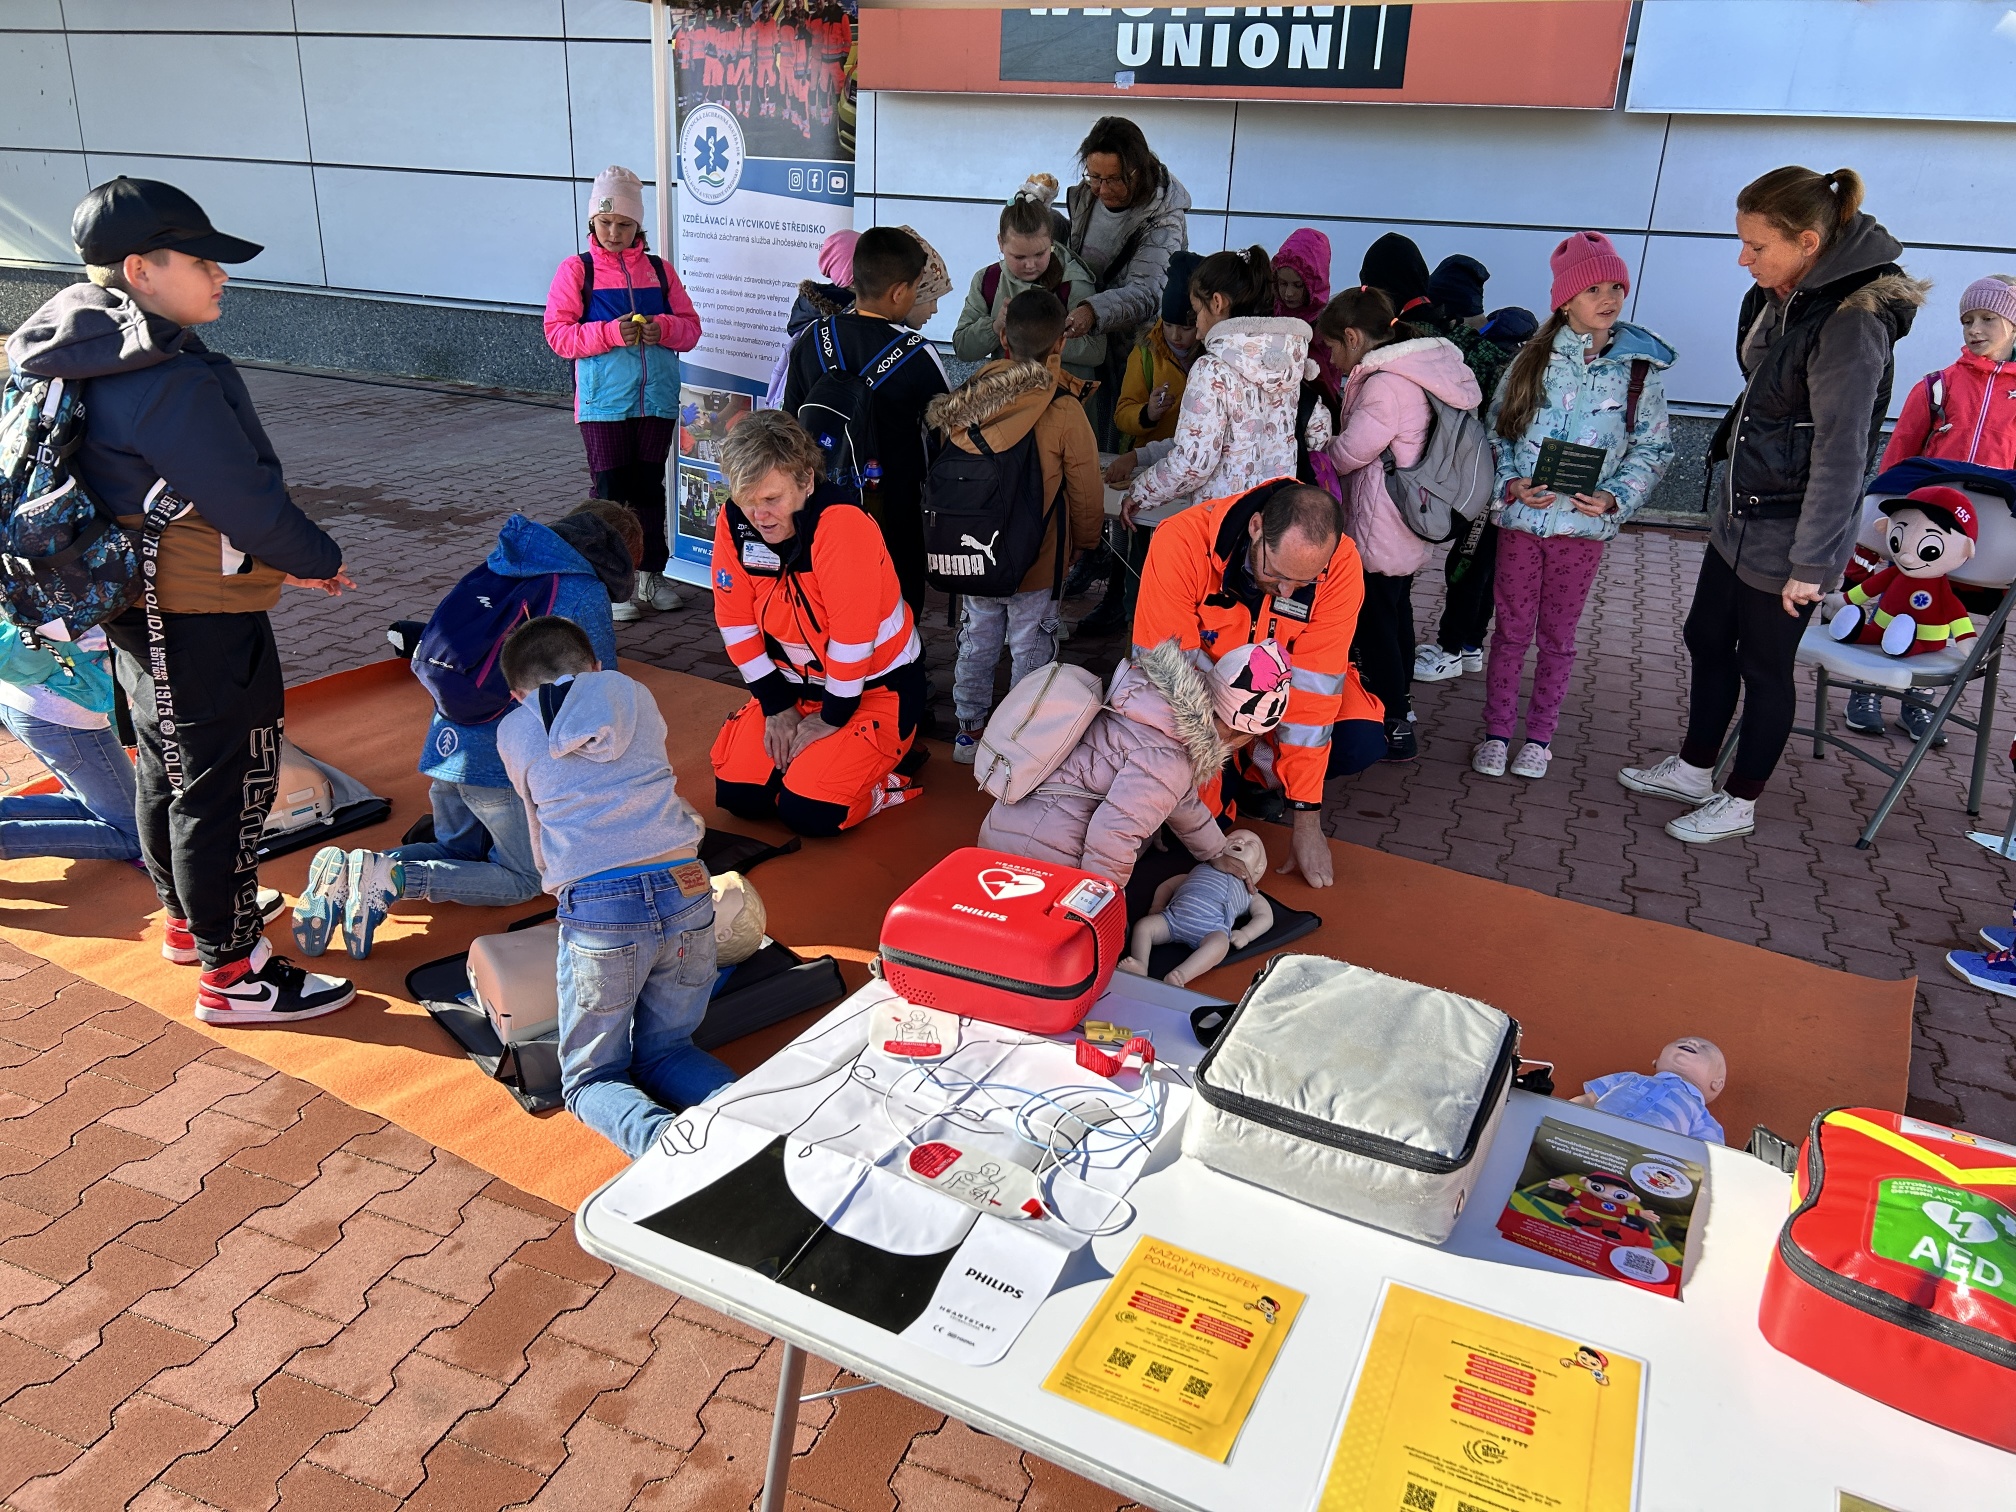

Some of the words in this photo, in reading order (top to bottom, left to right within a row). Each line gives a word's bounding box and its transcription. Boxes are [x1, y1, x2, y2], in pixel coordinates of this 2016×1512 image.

[1116, 23, 1333, 70] UNION
[682, 213, 728, 227] VZDĚLÁVACÍ
[729, 217, 735, 227] A
[736, 216, 780, 231] VÝCVIKOVÉ
[782, 220, 826, 235] STŘEDISKO
[682, 229, 718, 241] Zdravotnická
[719, 232, 750, 243] záchranná
[751, 235, 771, 246] služba
[772, 237, 808, 249] Jihočeského
[781, 280, 799, 289] pracov
[769, 324, 788, 333] záchra
[1954, 506, 1972, 524] 155
[927, 552, 985, 576] PUMA
[143, 578, 165, 643] AOLIDA
[149, 646, 162, 680] EDITION
[159, 647, 169, 681] LIMITED
[155, 684, 174, 716] 1975
[995, 860, 1054, 877] HEARTSTART
[951, 903, 1009, 922] PHILIPS
[1143, 1253, 1196, 1280] POMÁHÁ
[1148, 1244, 1190, 1266] KAŽDÝ
[1189, 1261, 1261, 1292] KRYŠTŮFEK
[1909, 1235, 2004, 1288] AED
[965, 1267, 1024, 1299] PHILIPS
[939, 1305, 997, 1333] HEARTSTART
